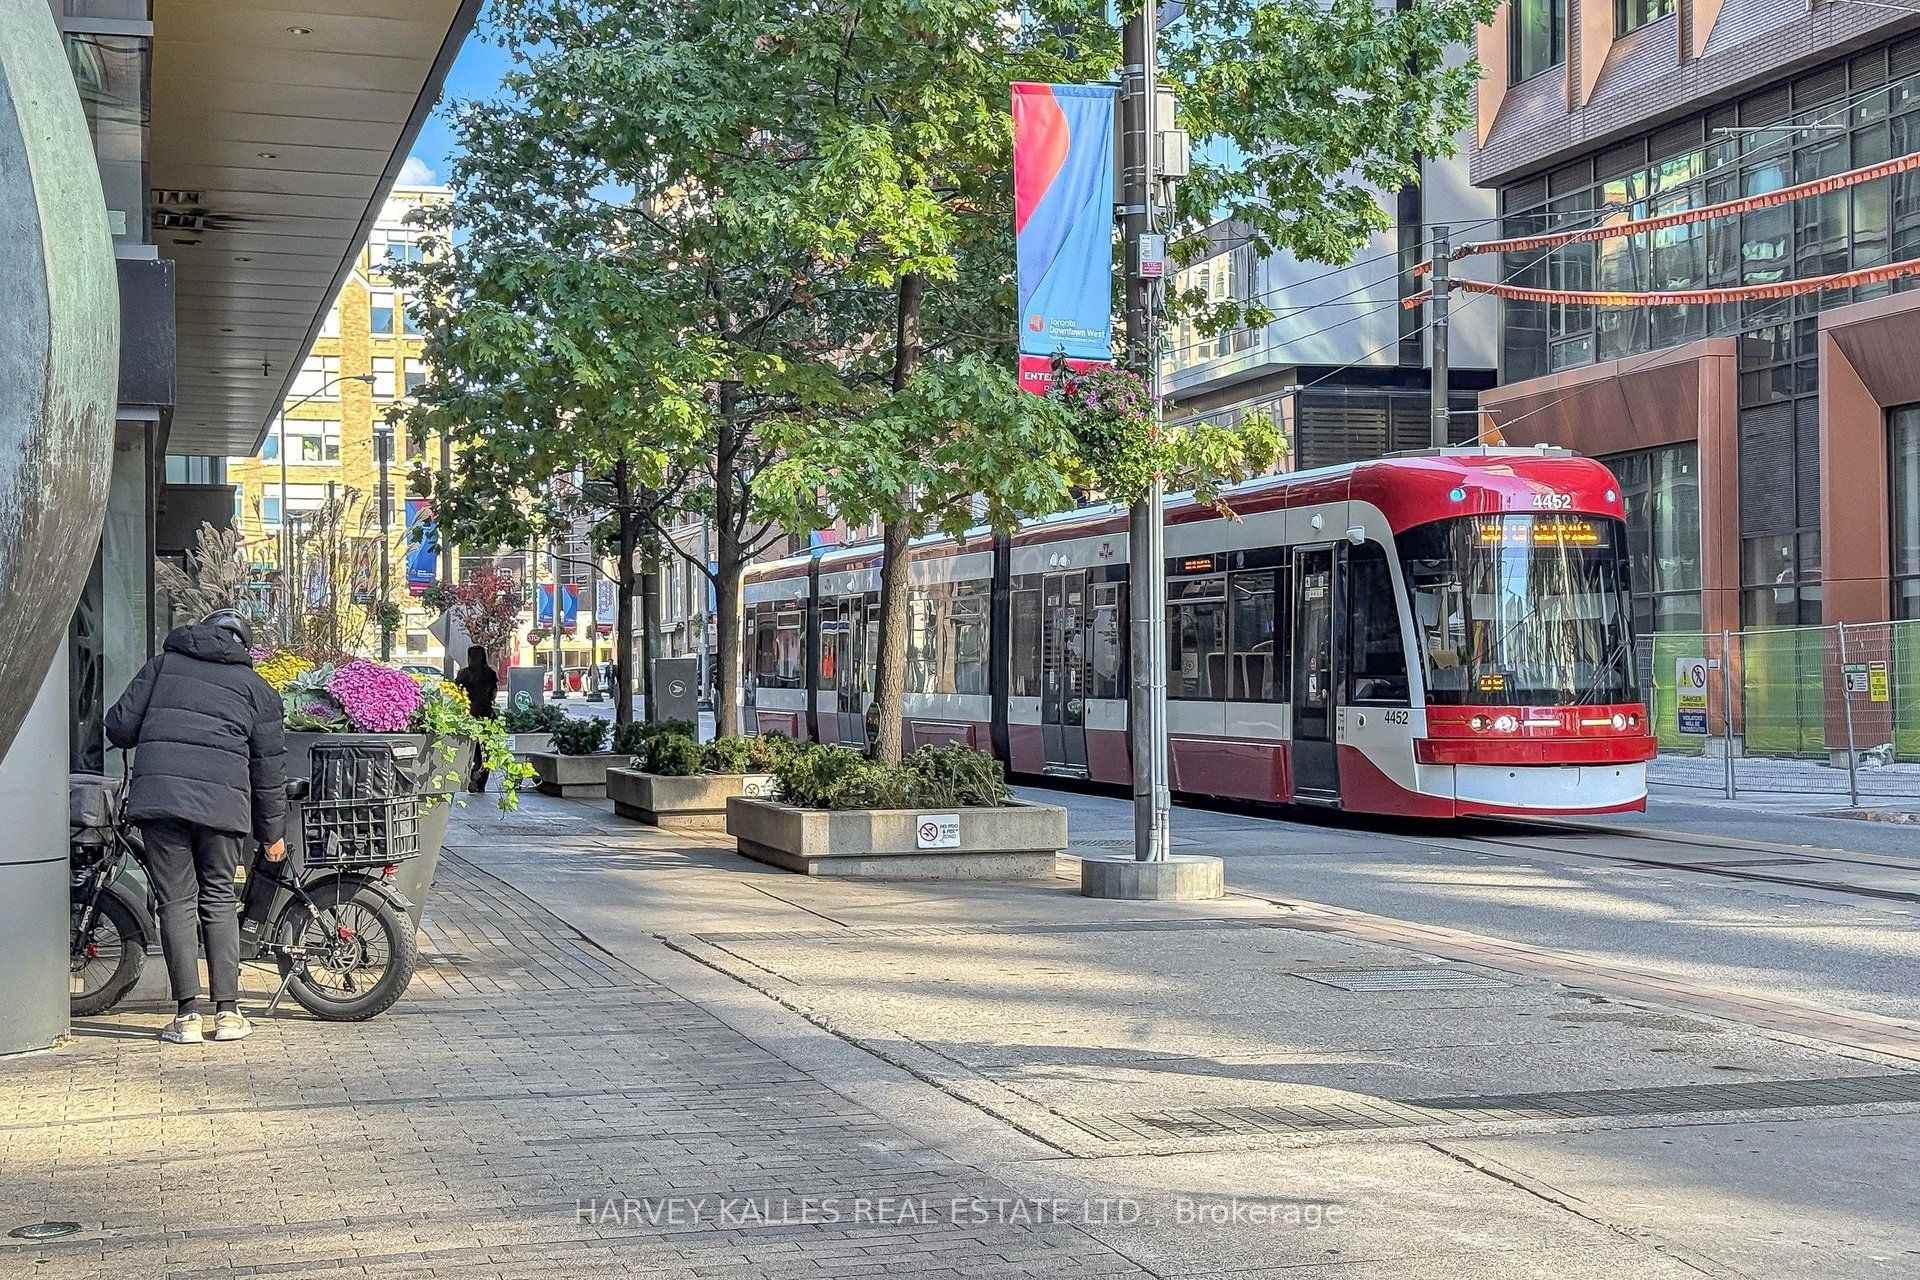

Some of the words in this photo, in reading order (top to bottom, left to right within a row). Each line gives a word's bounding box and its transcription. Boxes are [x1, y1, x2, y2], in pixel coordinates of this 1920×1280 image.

[1050, 318, 1077, 328] Toronto
[1050, 326, 1086, 337] Downtown
[1086, 328, 1105, 338] West
[1533, 493, 1572, 509] 4452
[1384, 711, 1409, 725] 4452
